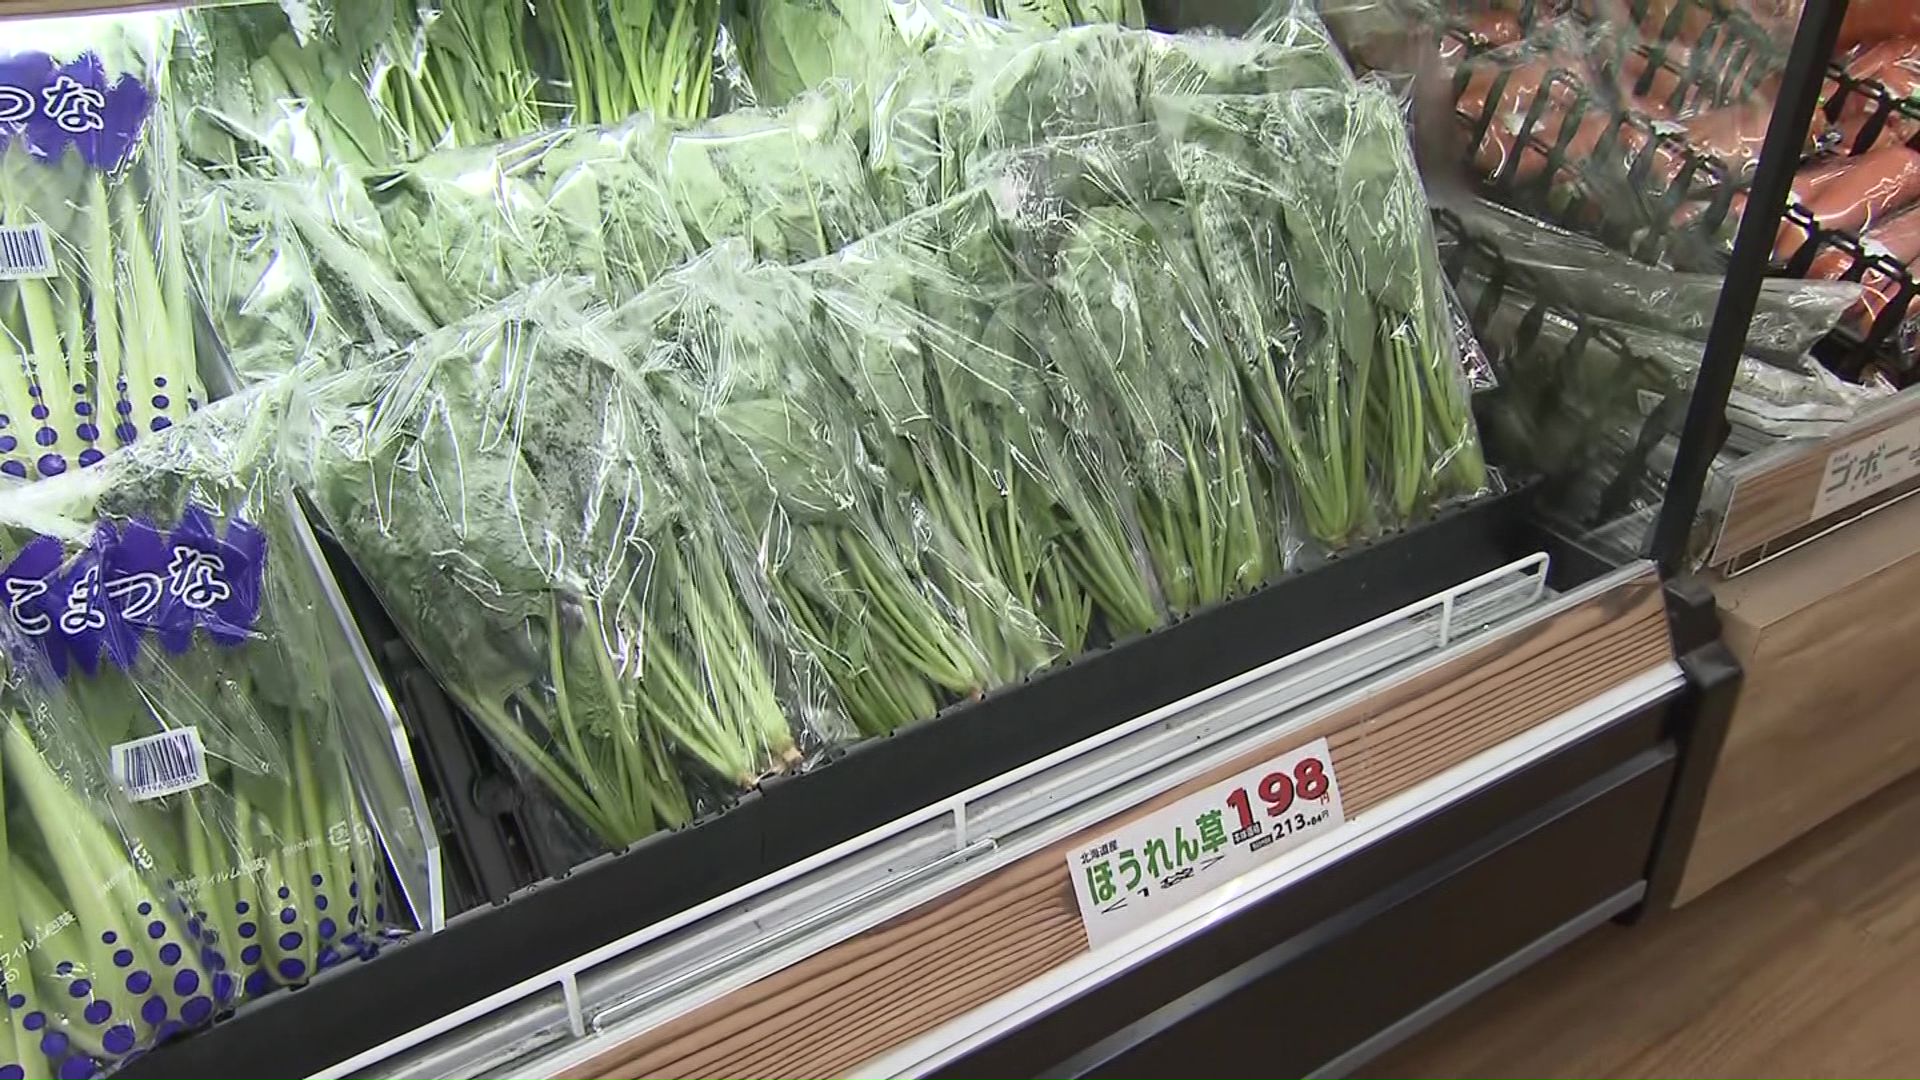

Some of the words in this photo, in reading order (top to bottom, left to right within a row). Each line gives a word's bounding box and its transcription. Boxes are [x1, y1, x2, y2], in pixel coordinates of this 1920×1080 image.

[1825, 442, 1920, 494] ゴボー
[6, 546, 230, 635] こまつな
[1085, 809, 1228, 906] ほうれん草
